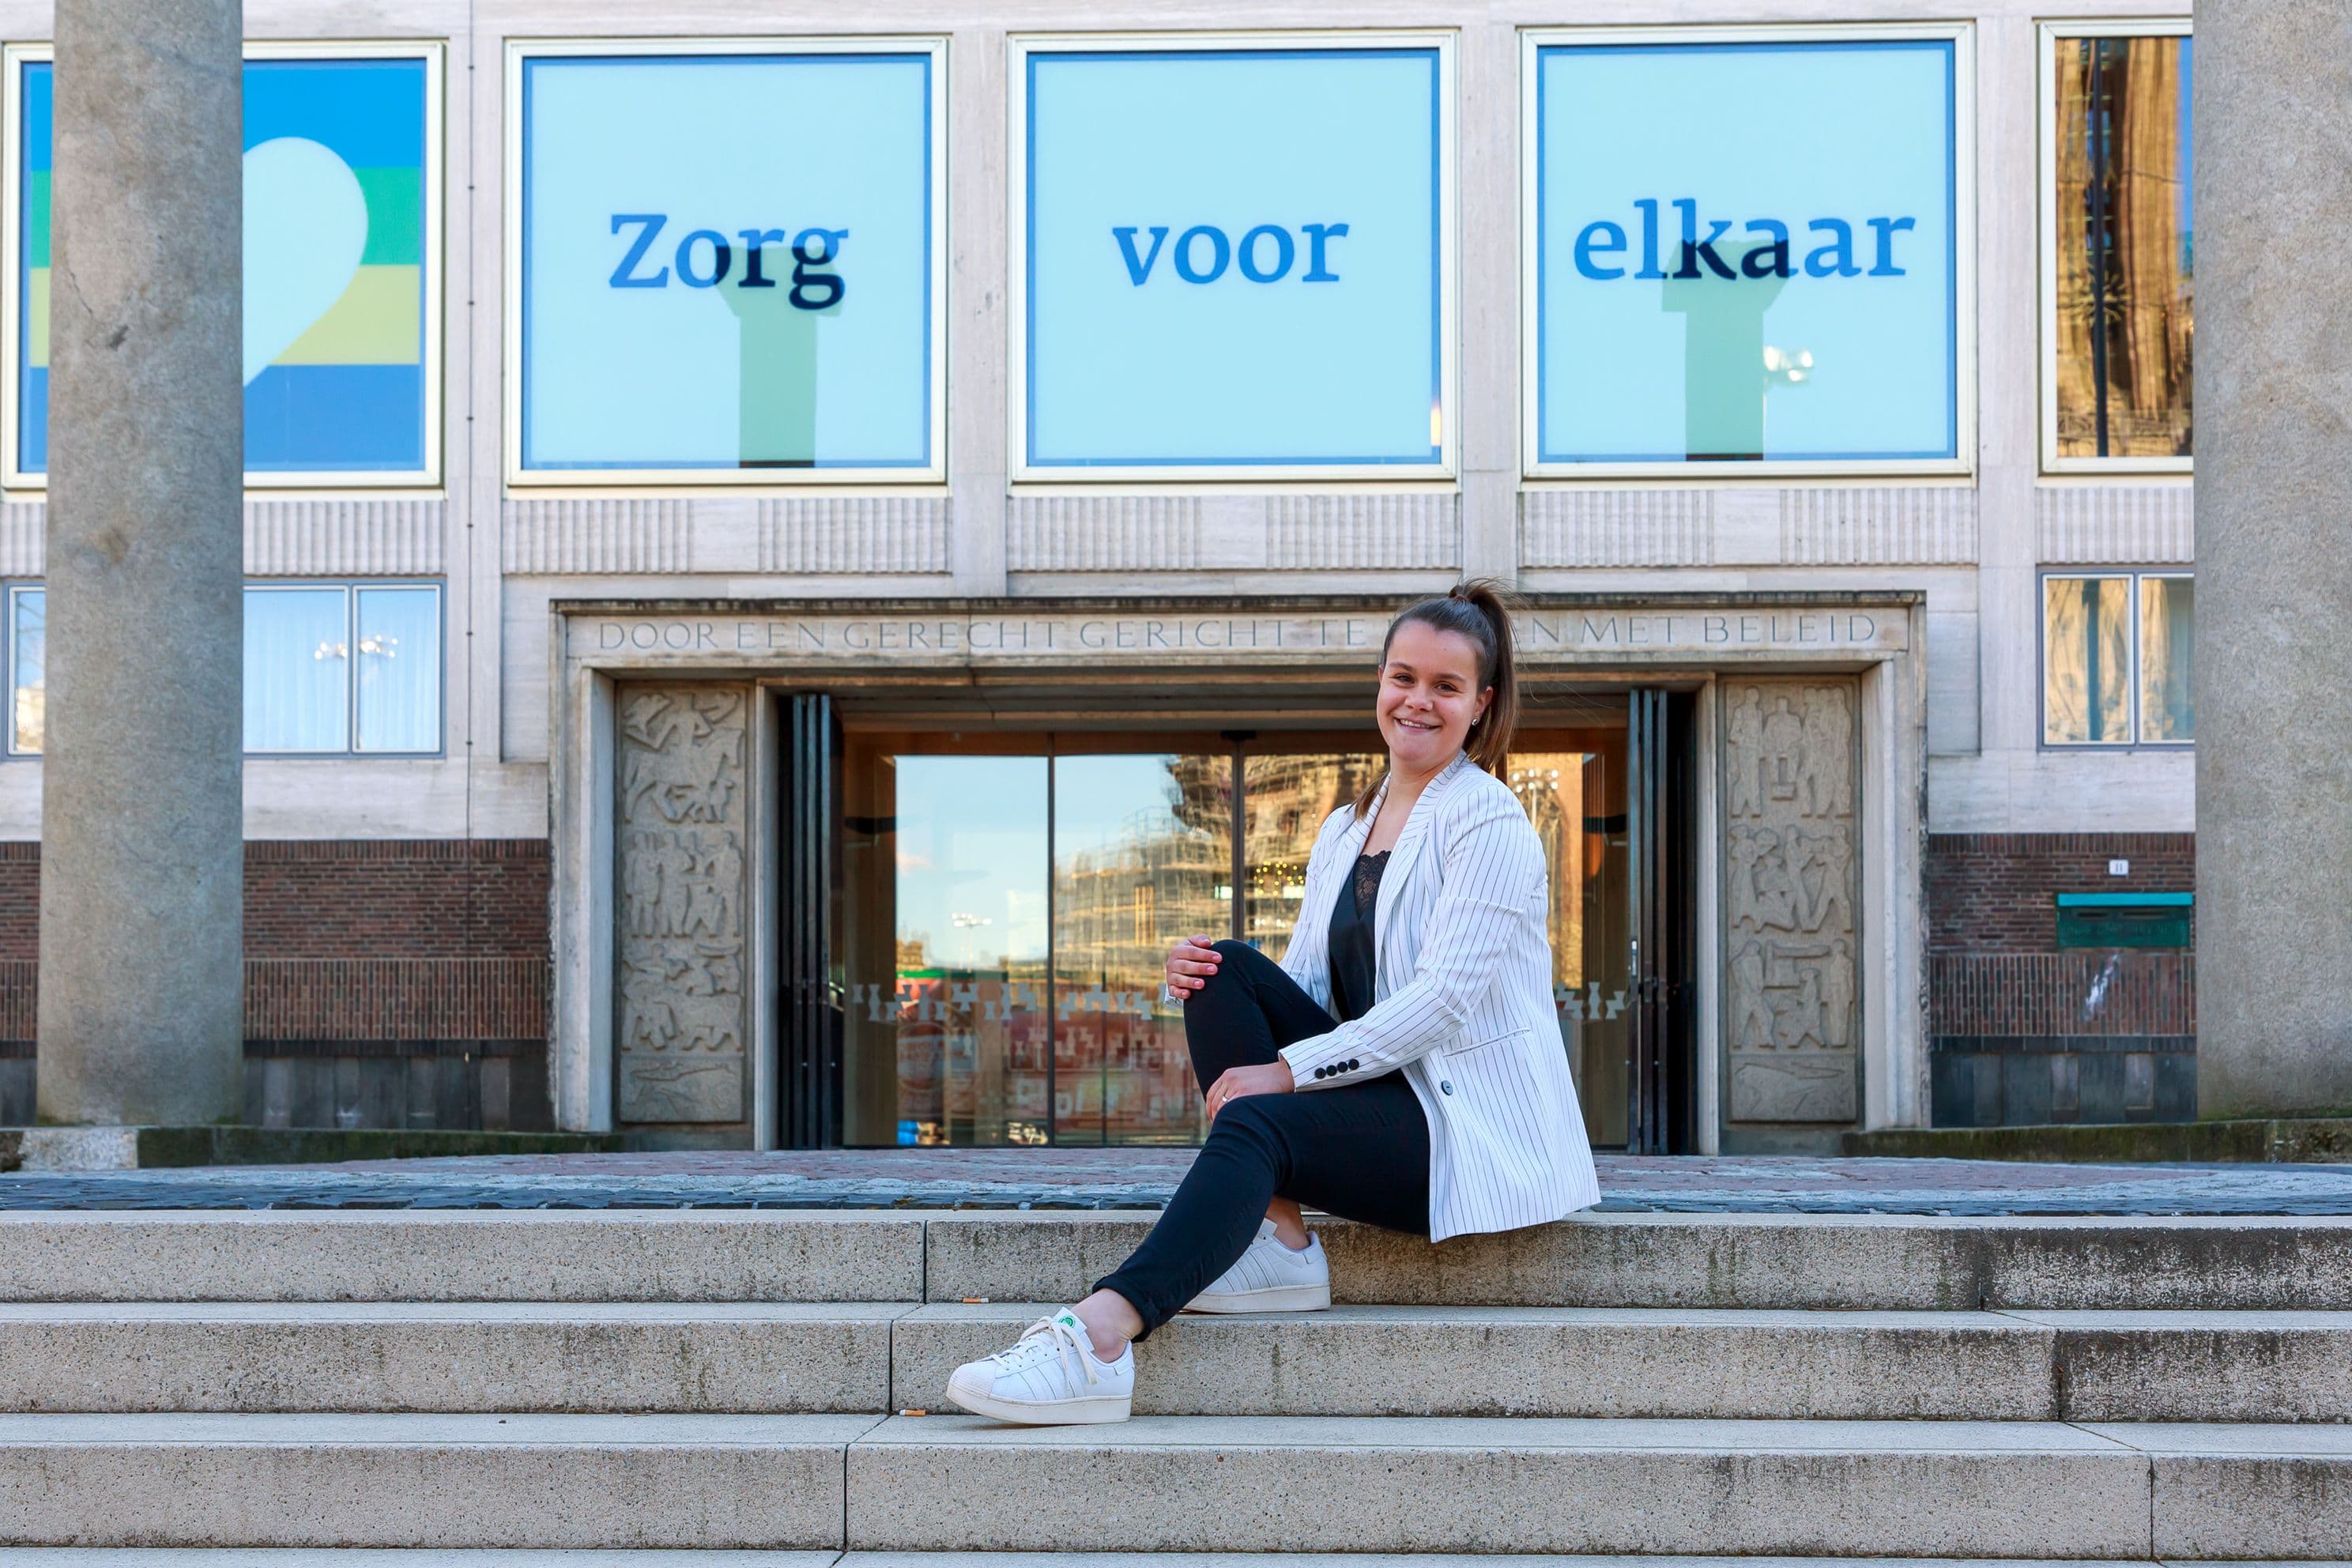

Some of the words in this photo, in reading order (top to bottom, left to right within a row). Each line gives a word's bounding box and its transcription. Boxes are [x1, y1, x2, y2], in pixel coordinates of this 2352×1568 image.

[609, 213, 850, 311] Zorg
[1112, 223, 1350, 287] voor
[1574, 198, 1917, 281] elkaar
[599, 622, 718, 650] DOOR
[737, 622, 824, 649] EEN
[844, 621, 1065, 649] GERECHT
[1080, 620, 1293, 648] GERICHT
[1309, 619, 1366, 646] TE
[1580, 616, 1683, 644] MET
[1704, 615, 1875, 643] BELEID
